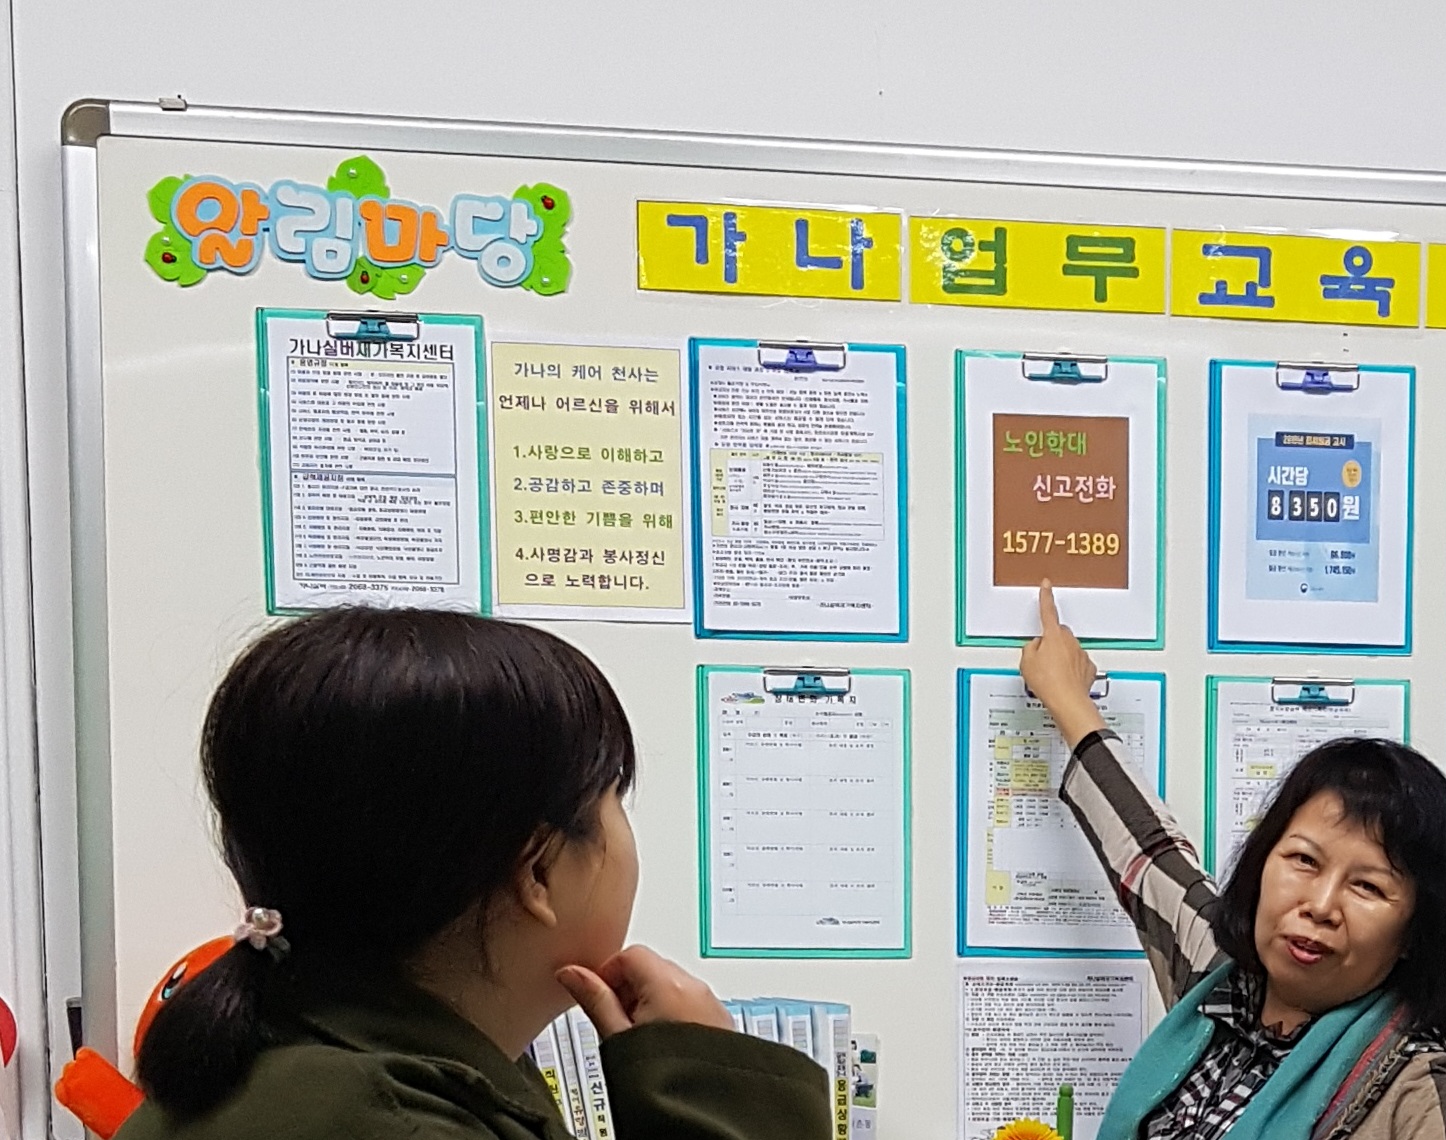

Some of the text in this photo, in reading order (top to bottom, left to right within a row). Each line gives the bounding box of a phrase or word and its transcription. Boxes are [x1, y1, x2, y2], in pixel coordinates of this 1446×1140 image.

[176, 181, 539, 283] 알림마당
[289, 338, 455, 362] 가나실버재가복지센터
[514, 362, 659, 383] 가나의 케어 천사는
[499, 395, 676, 416] 언제나 어르신을 위해서
[513, 445, 664, 464] 1.사랑으로 이해하고
[1003, 430, 1087, 458] 노인학대
[1268, 465, 1309, 486] 시간당
[513, 477, 664, 497] 2.공감하고 존중하며
[1033, 475, 1117, 503] 신고전화
[514, 510, 673, 529] 3.편안한 기쁨을 위해
[1002, 530, 1120, 556] 1577-1389
[515, 547, 665, 566] 4.사명감과 봉사정신
[524, 573, 650, 590] 으로 노력합니다.
